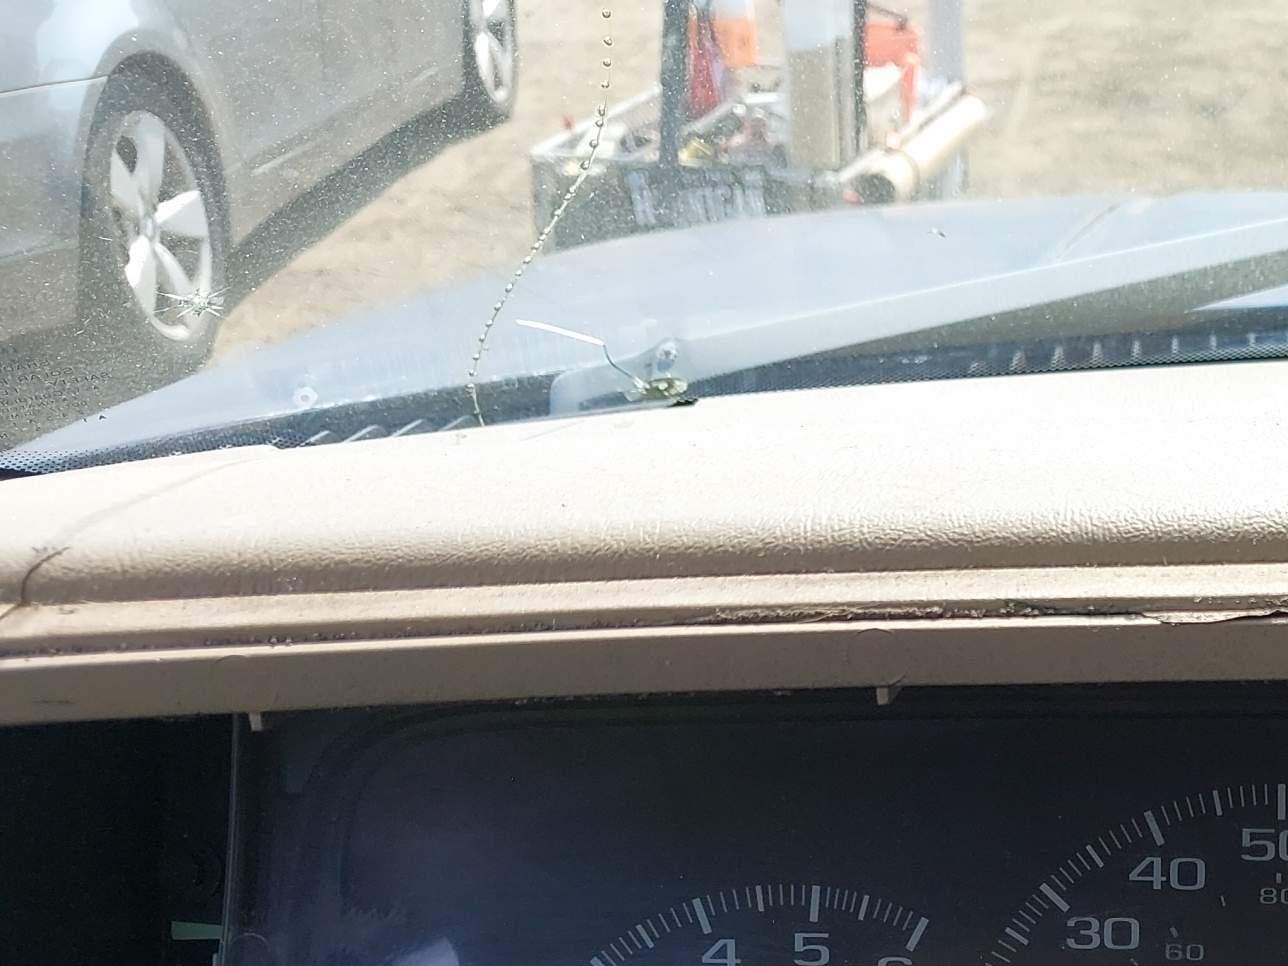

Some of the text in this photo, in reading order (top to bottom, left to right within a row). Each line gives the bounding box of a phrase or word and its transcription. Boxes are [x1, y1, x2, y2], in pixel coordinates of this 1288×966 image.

[1129, 857, 1205, 890] 40
[1067, 917, 1139, 949] 30
[794, 933, 830, 966] 5
[1166, 944, 1204, 960] 60
